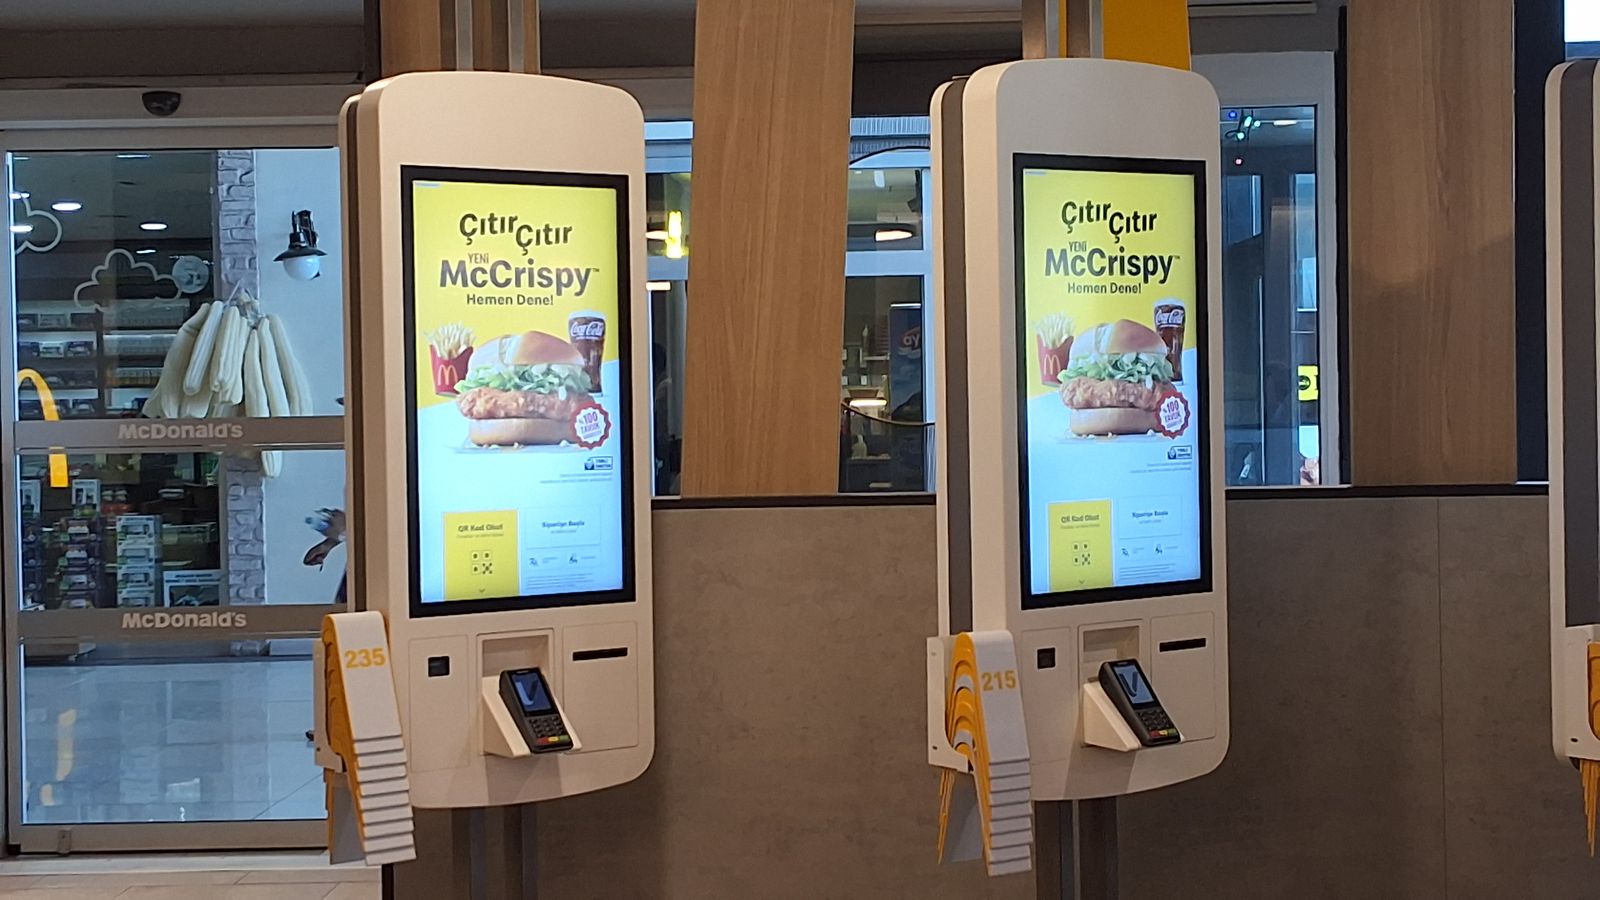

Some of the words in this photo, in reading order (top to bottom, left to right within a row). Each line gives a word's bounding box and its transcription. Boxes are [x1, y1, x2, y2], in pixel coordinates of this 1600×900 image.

[1061, 200, 1111, 234] Çıtır
[1109, 210, 1157, 244] Çıtır
[459, 213, 518, 245] Çıtır
[516, 223, 572, 256] Çıtır
[1045, 246, 1173, 284] McCrispy
[440, 258, 591, 297] McCrispy
[1068, 282, 1107, 294] Hemen
[1110, 282, 1142, 294] Dene!
[467, 293, 513, 305] Hemen
[517, 294, 554, 306] Dene!
[119, 423, 243, 439] McDonald's
[121, 612, 247, 628] McDonald's
[344, 648, 386, 669] 235
[982, 670, 1017, 691] 215
